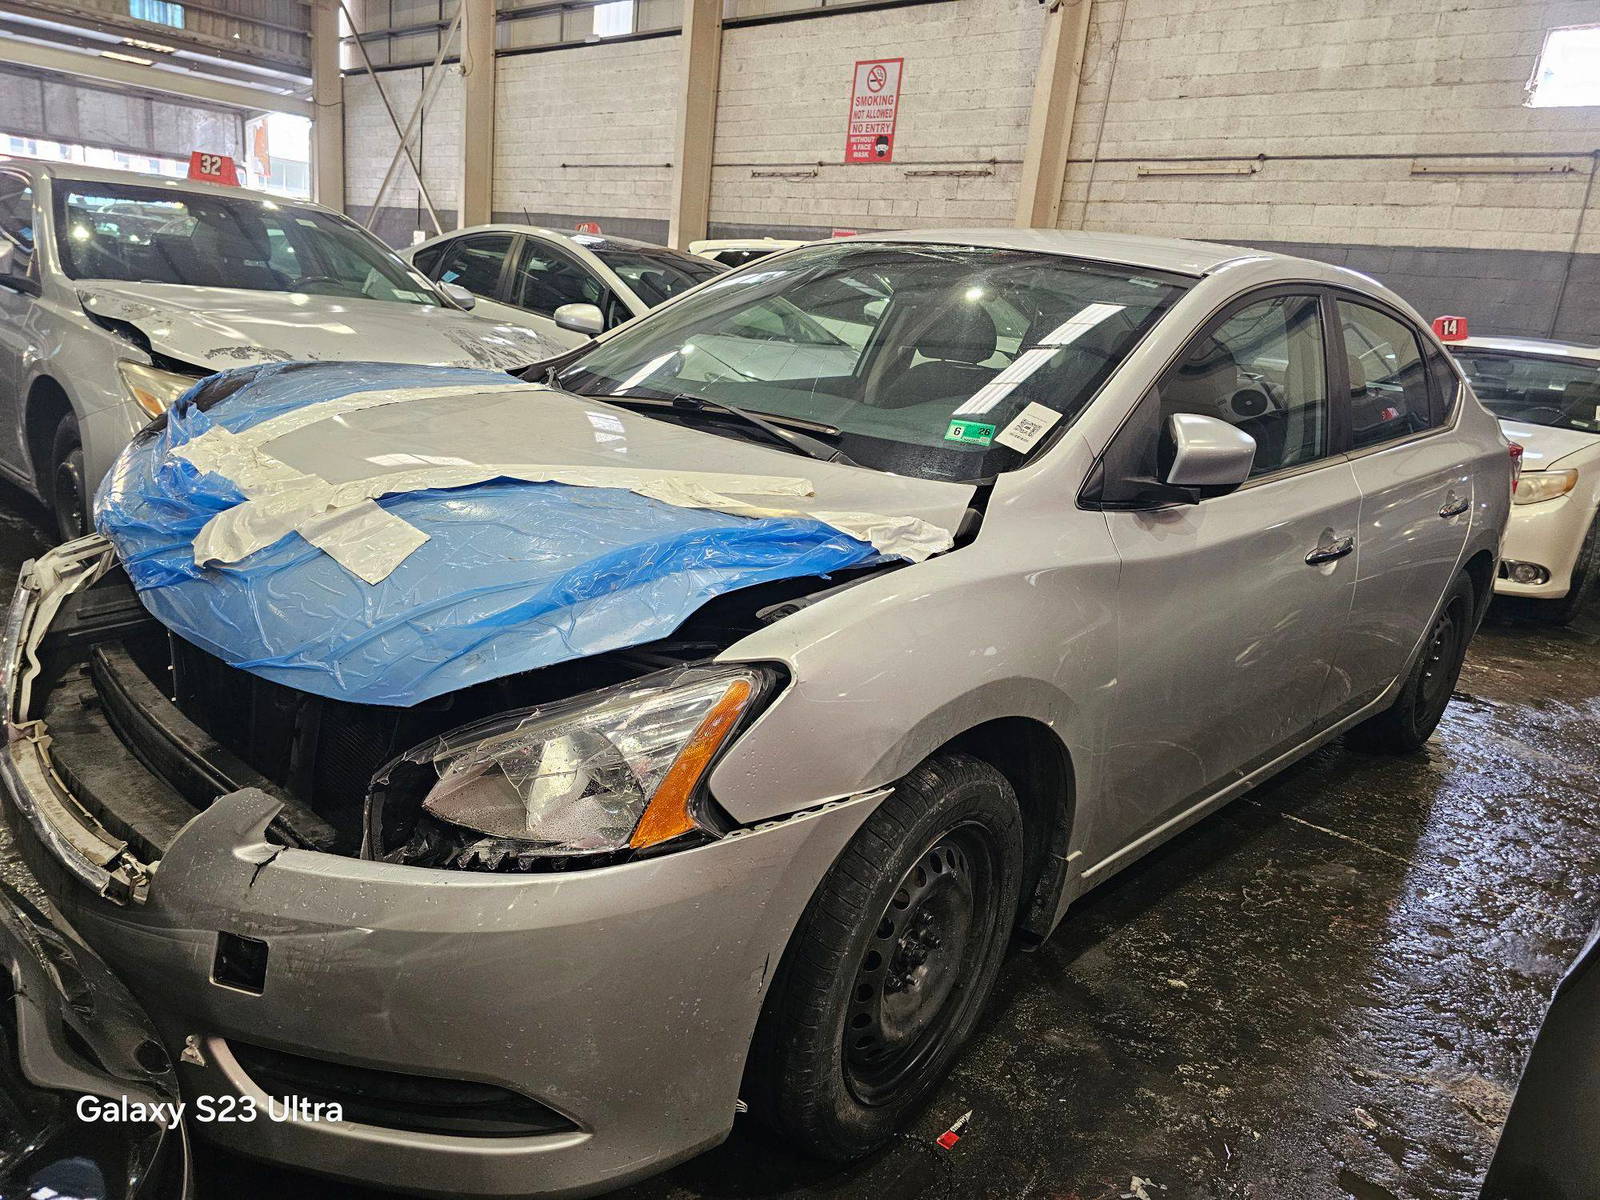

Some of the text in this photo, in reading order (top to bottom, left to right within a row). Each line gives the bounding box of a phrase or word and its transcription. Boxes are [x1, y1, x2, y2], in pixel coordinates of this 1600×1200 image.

[855, 95, 894, 106] SMOKING
[853, 109, 893, 119] NOT ALLOWED
[852, 123, 891, 133] NO ENTRY
[201, 154, 222, 176] 32
[1443, 319, 1457, 335] 14
[953, 427, 990, 436] 6 26
